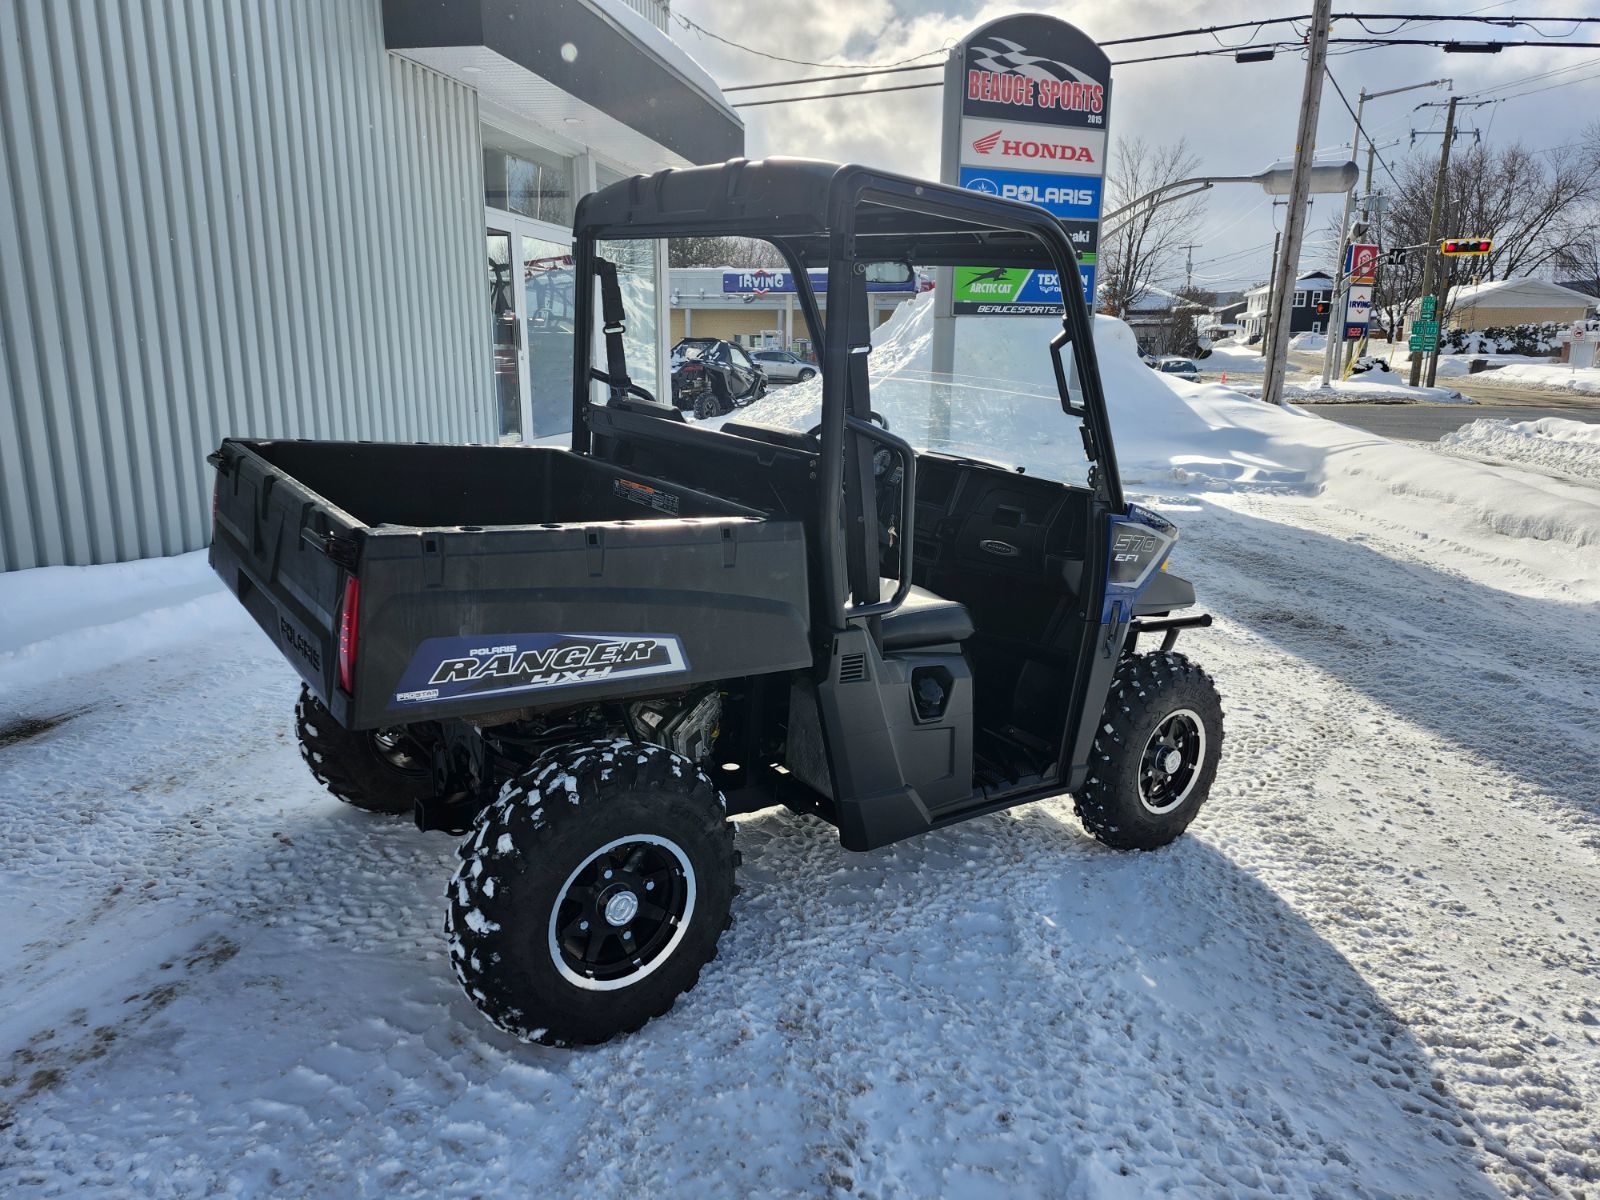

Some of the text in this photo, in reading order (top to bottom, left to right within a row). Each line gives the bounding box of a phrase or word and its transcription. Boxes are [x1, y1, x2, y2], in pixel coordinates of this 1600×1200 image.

[968, 70, 1103, 113] BEAUCE SPORTS
[1087, 115, 1102, 124] 2015
[1001, 140, 1094, 163] HONDA
[1002, 184, 1093, 205] POLARIS
[738, 273, 784, 289] IRVING
[970, 283, 1013, 294] ARCTIC CAT
[1349, 300, 1371, 308] IRVING
[1423, 302, 1434, 311] 216
[1113, 534, 1157, 553] 570
[1114, 553, 1139, 562] EFI
[280, 616, 320, 672] POLARIS
[469, 644, 517, 656] POLARIS
[428, 639, 658, 685] RANGER
